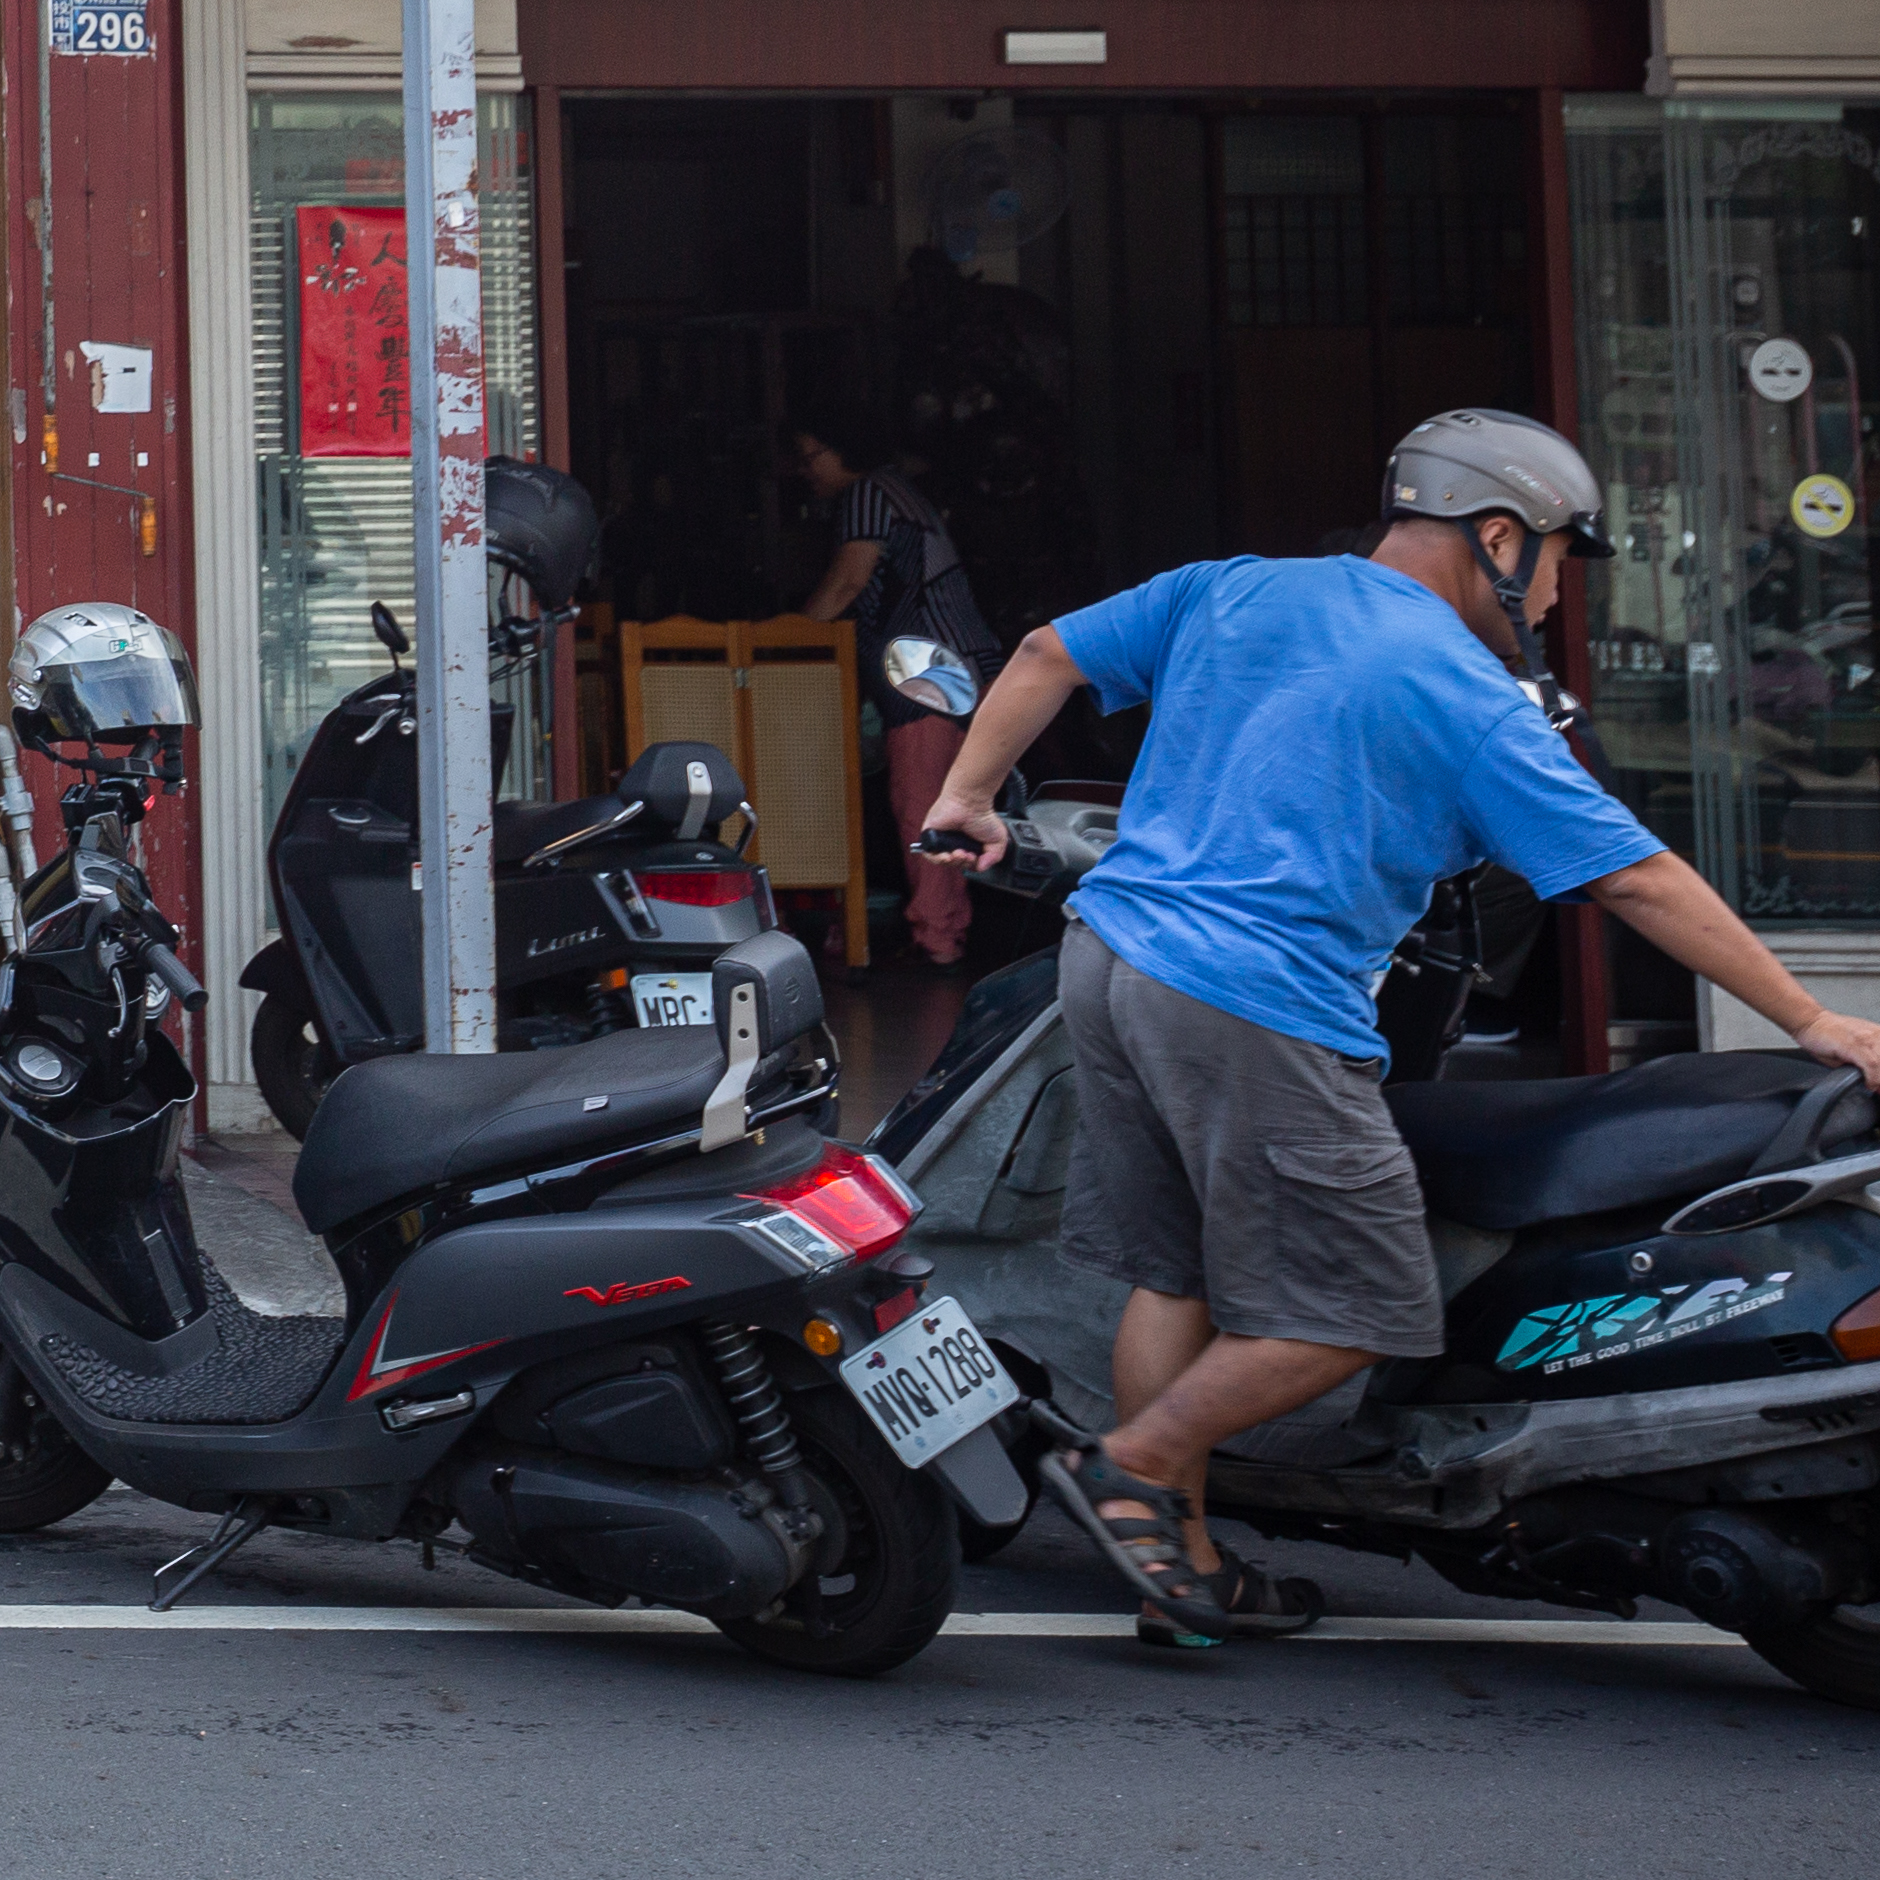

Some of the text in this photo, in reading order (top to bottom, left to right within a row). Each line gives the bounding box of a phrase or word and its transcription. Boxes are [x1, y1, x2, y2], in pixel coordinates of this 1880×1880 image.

[77, 12, 145, 50] 296
[563, 1275, 693, 1306] VEGA
[1543, 1360, 1565, 1374] LET
[1569, 1353, 1593, 1368] THE
[1597, 1342, 1630, 1360] GOOD
[1635, 1332, 1664, 1349] TIME
[863, 1327, 996, 1442] MVQ-1288
